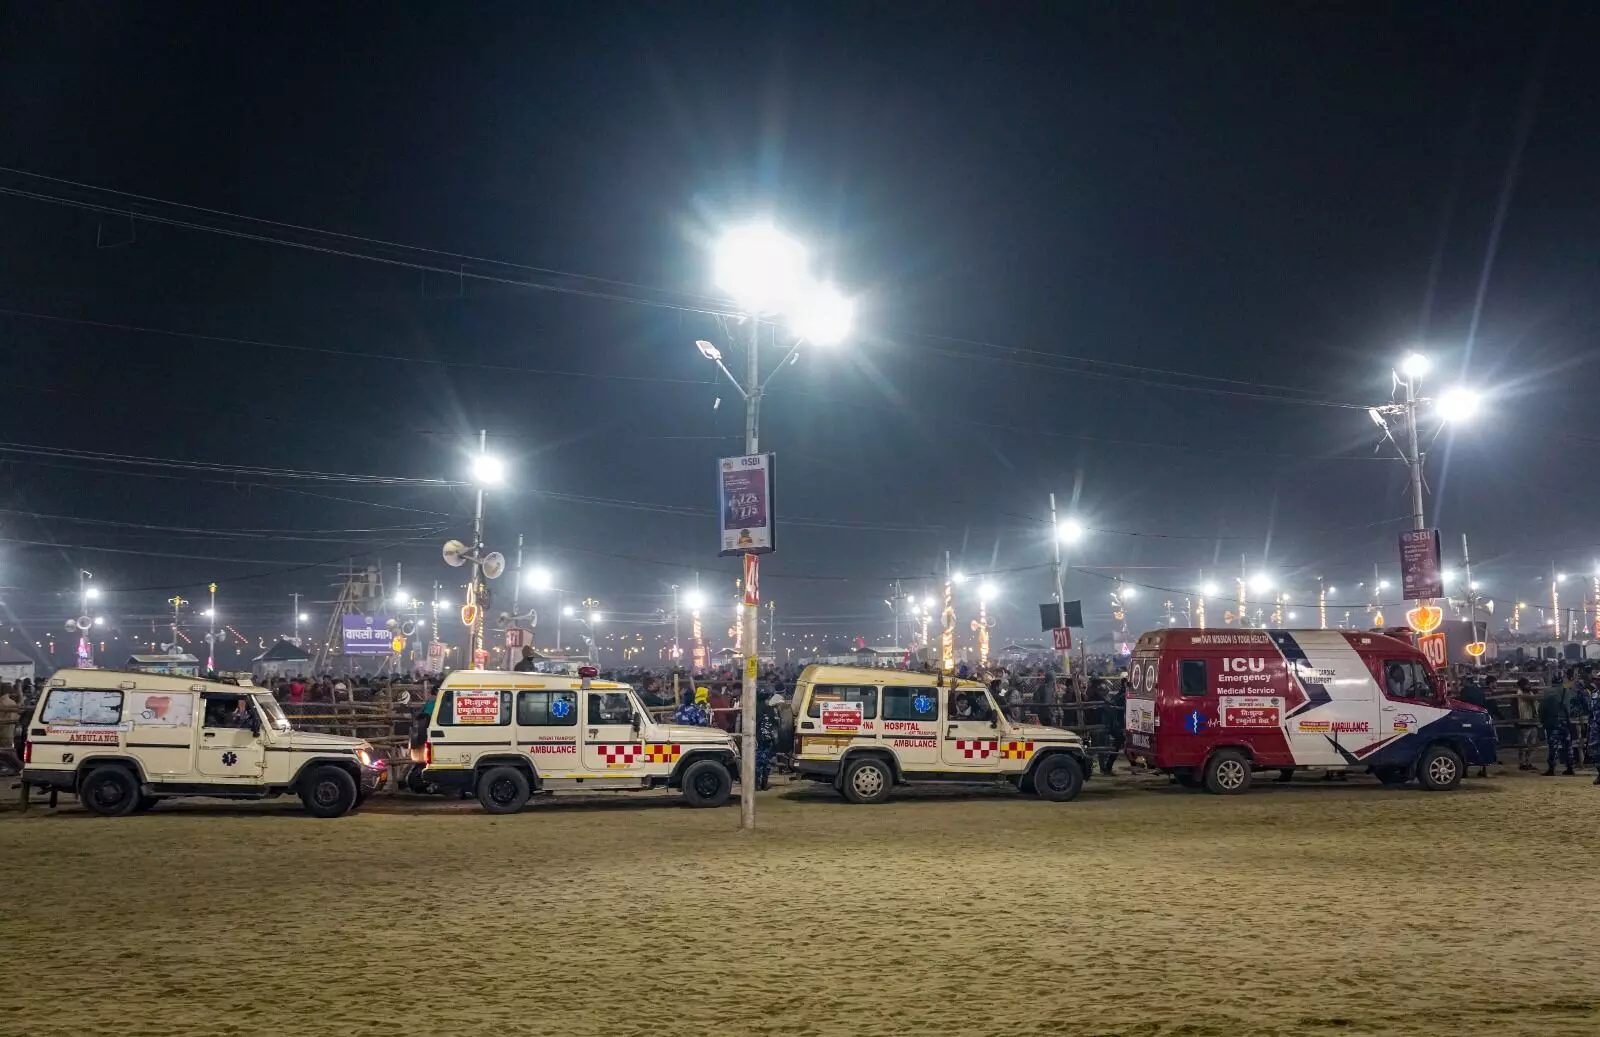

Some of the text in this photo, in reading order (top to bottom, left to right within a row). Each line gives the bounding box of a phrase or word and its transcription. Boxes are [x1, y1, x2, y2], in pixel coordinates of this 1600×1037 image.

[1055, 630, 1068, 649] 211
[1223, 657, 1264, 673] ICU
[1218, 674, 1271, 683] Emergency
[1216, 686, 1276, 695] Medical Service
[884, 722, 920, 730] HOSPITAL
[1331, 722, 1369, 732] AMBULANCE
[69, 734, 119, 743] AMBULANCE
[894, 740, 937, 748] AMBULANCE
[530, 745, 577, 753] AMBULANCE
